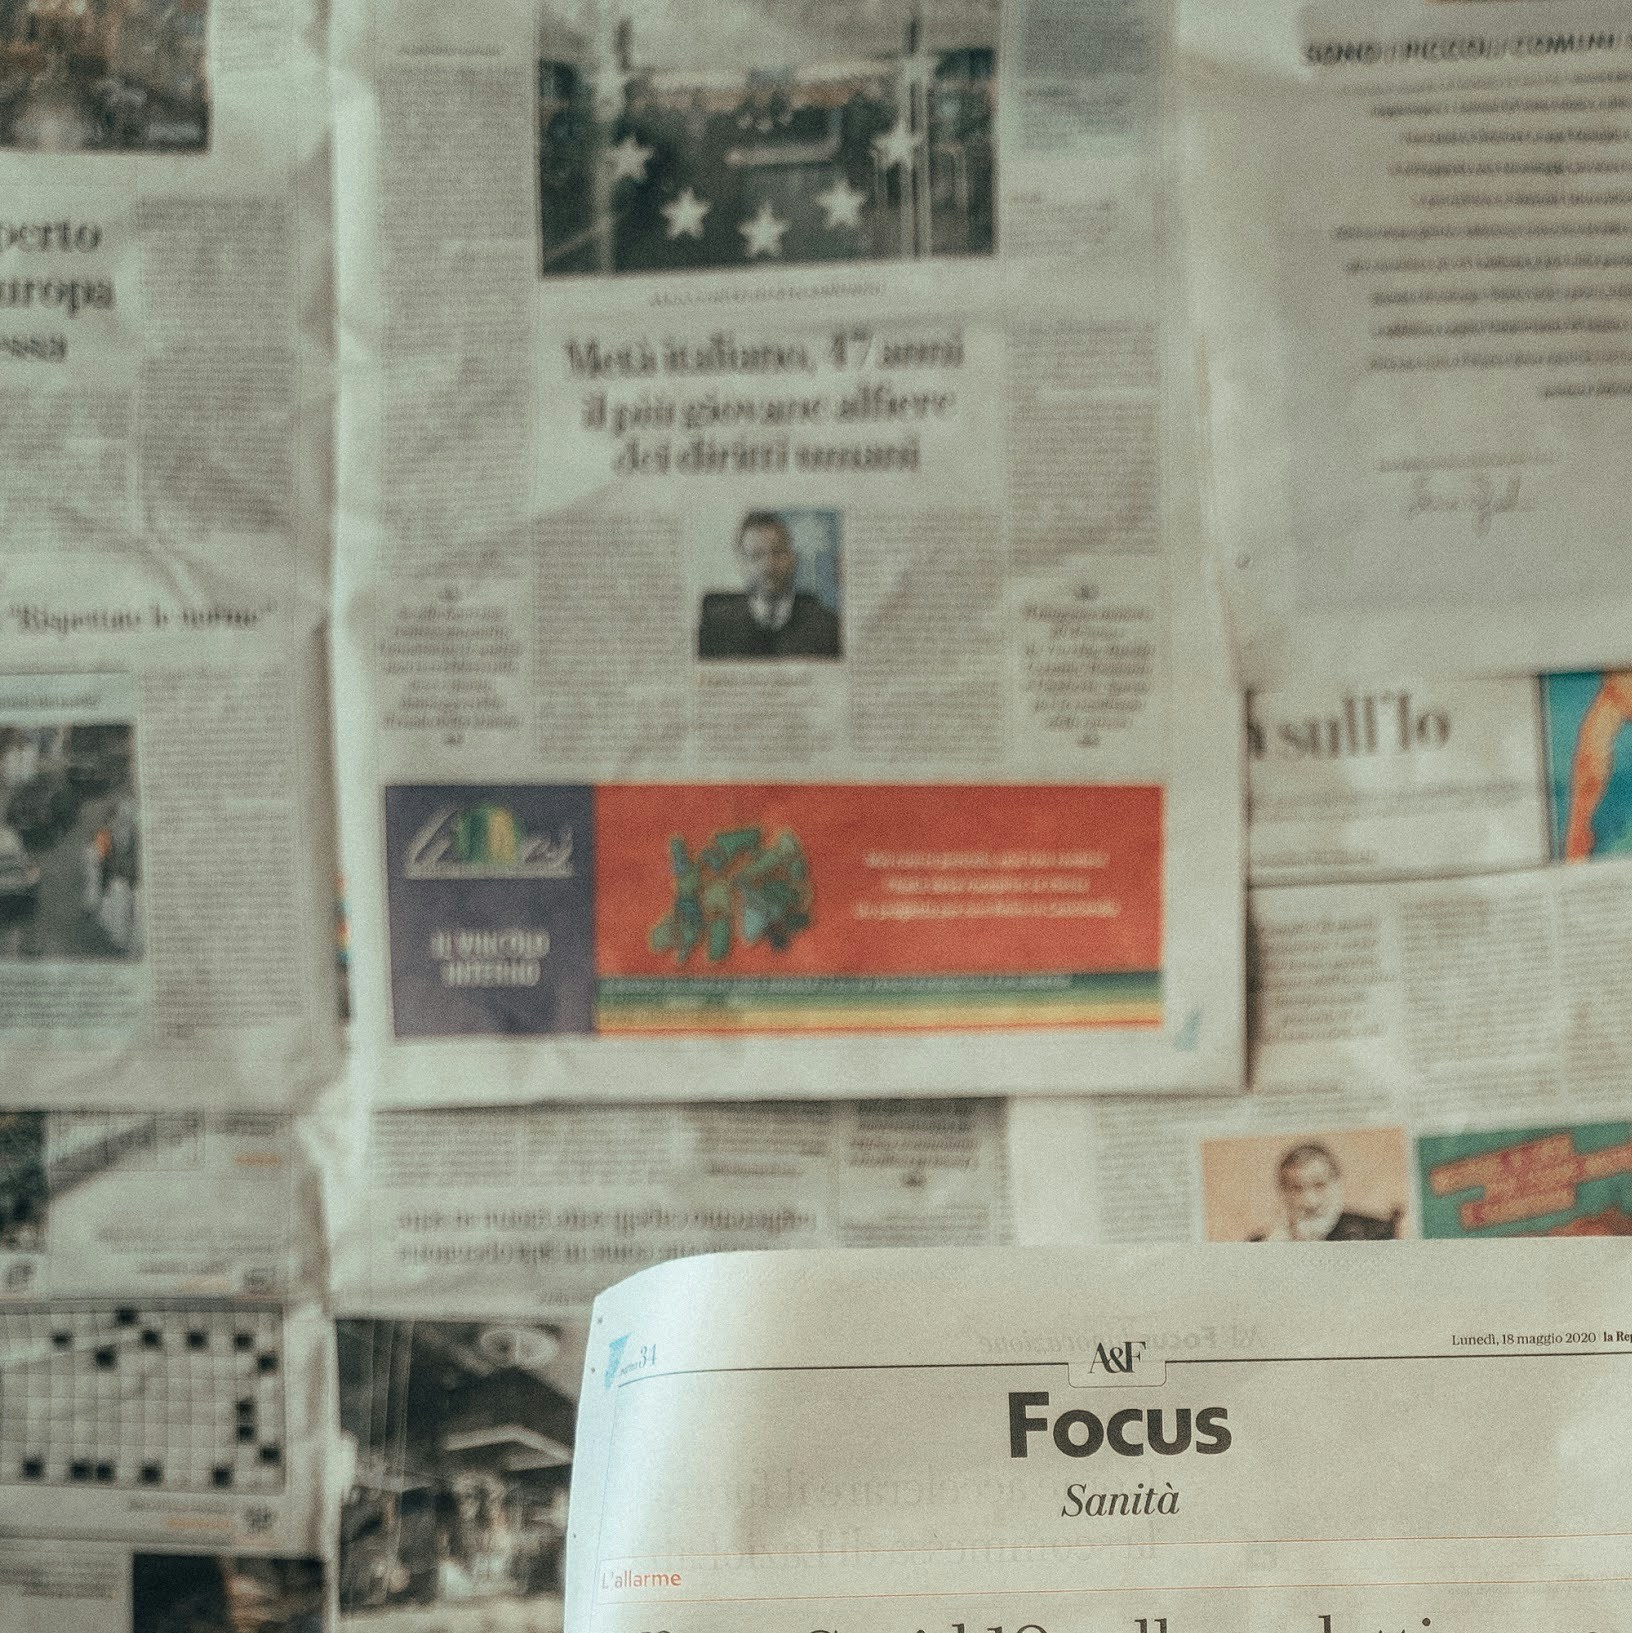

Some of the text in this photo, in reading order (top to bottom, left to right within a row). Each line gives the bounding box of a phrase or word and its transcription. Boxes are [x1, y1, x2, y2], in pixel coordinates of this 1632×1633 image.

[1086, 1339, 1148, 1376] A&F
[1451, 1333, 1500, 1346] Lunedì,
[1501, 1333, 1515, 1345] 18
[1516, 1333, 1564, 1346] maggio
[1565, 1332, 1597, 1344] 2020
[1006, 1390, 1233, 1460] Focus
[1060, 1480, 1180, 1518] Sanità
